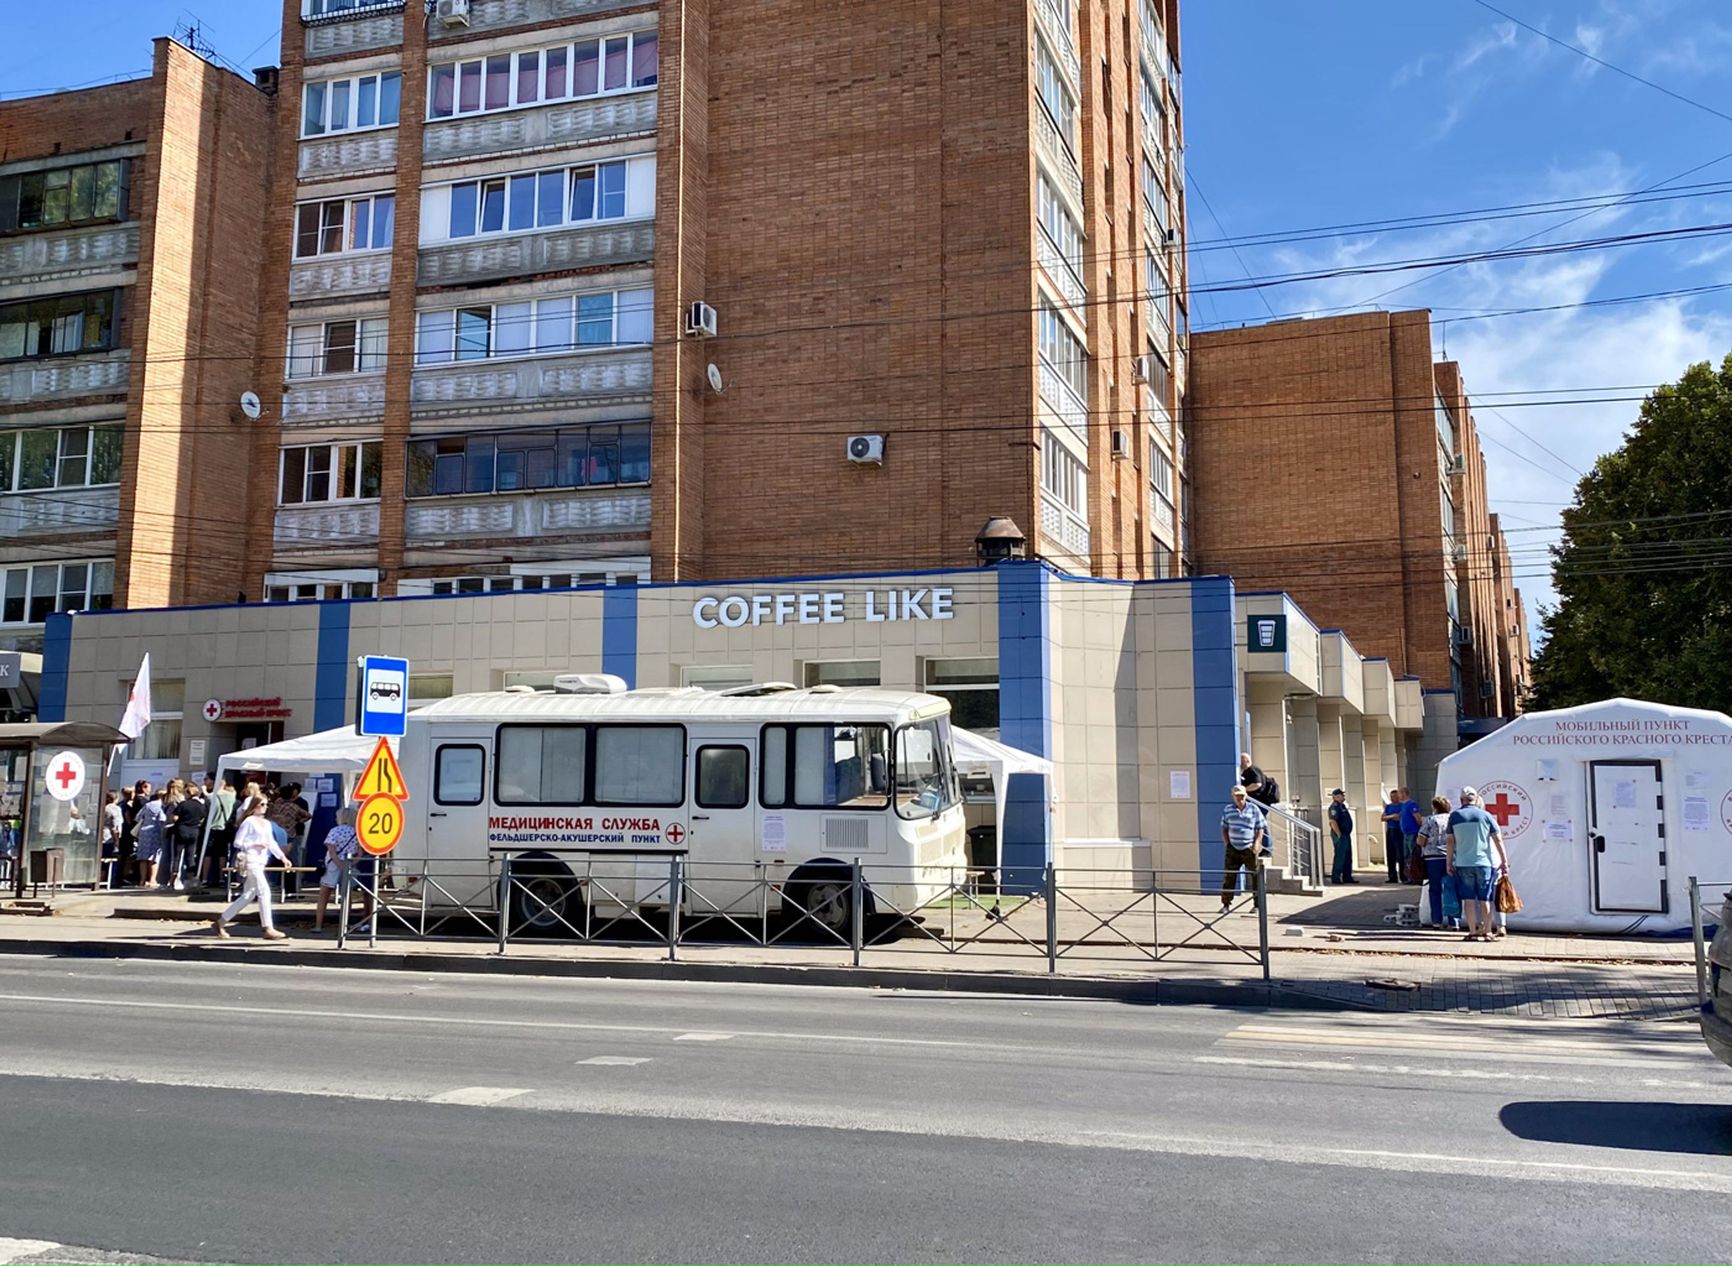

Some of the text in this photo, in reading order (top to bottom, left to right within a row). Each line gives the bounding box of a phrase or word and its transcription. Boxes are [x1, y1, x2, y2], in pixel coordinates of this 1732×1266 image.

[692, 587, 954, 629] COFFEE LIKE
[1555, 719, 1690, 731] МОБИЛЬНЫЙ ПУНКТ
[1513, 732, 1610, 745] РОССИЙСКОГО
[1612, 733, 1682, 745] КРАСНОГО
[368, 812, 393, 834] 20
[489, 817, 660, 831] МЕДИЦИНСКАЯ СЛУЖБА
[489, 833, 661, 843] ФЕЛЬДШЕРСКО-АКУШЕРСКИЙ ПУНКТ
